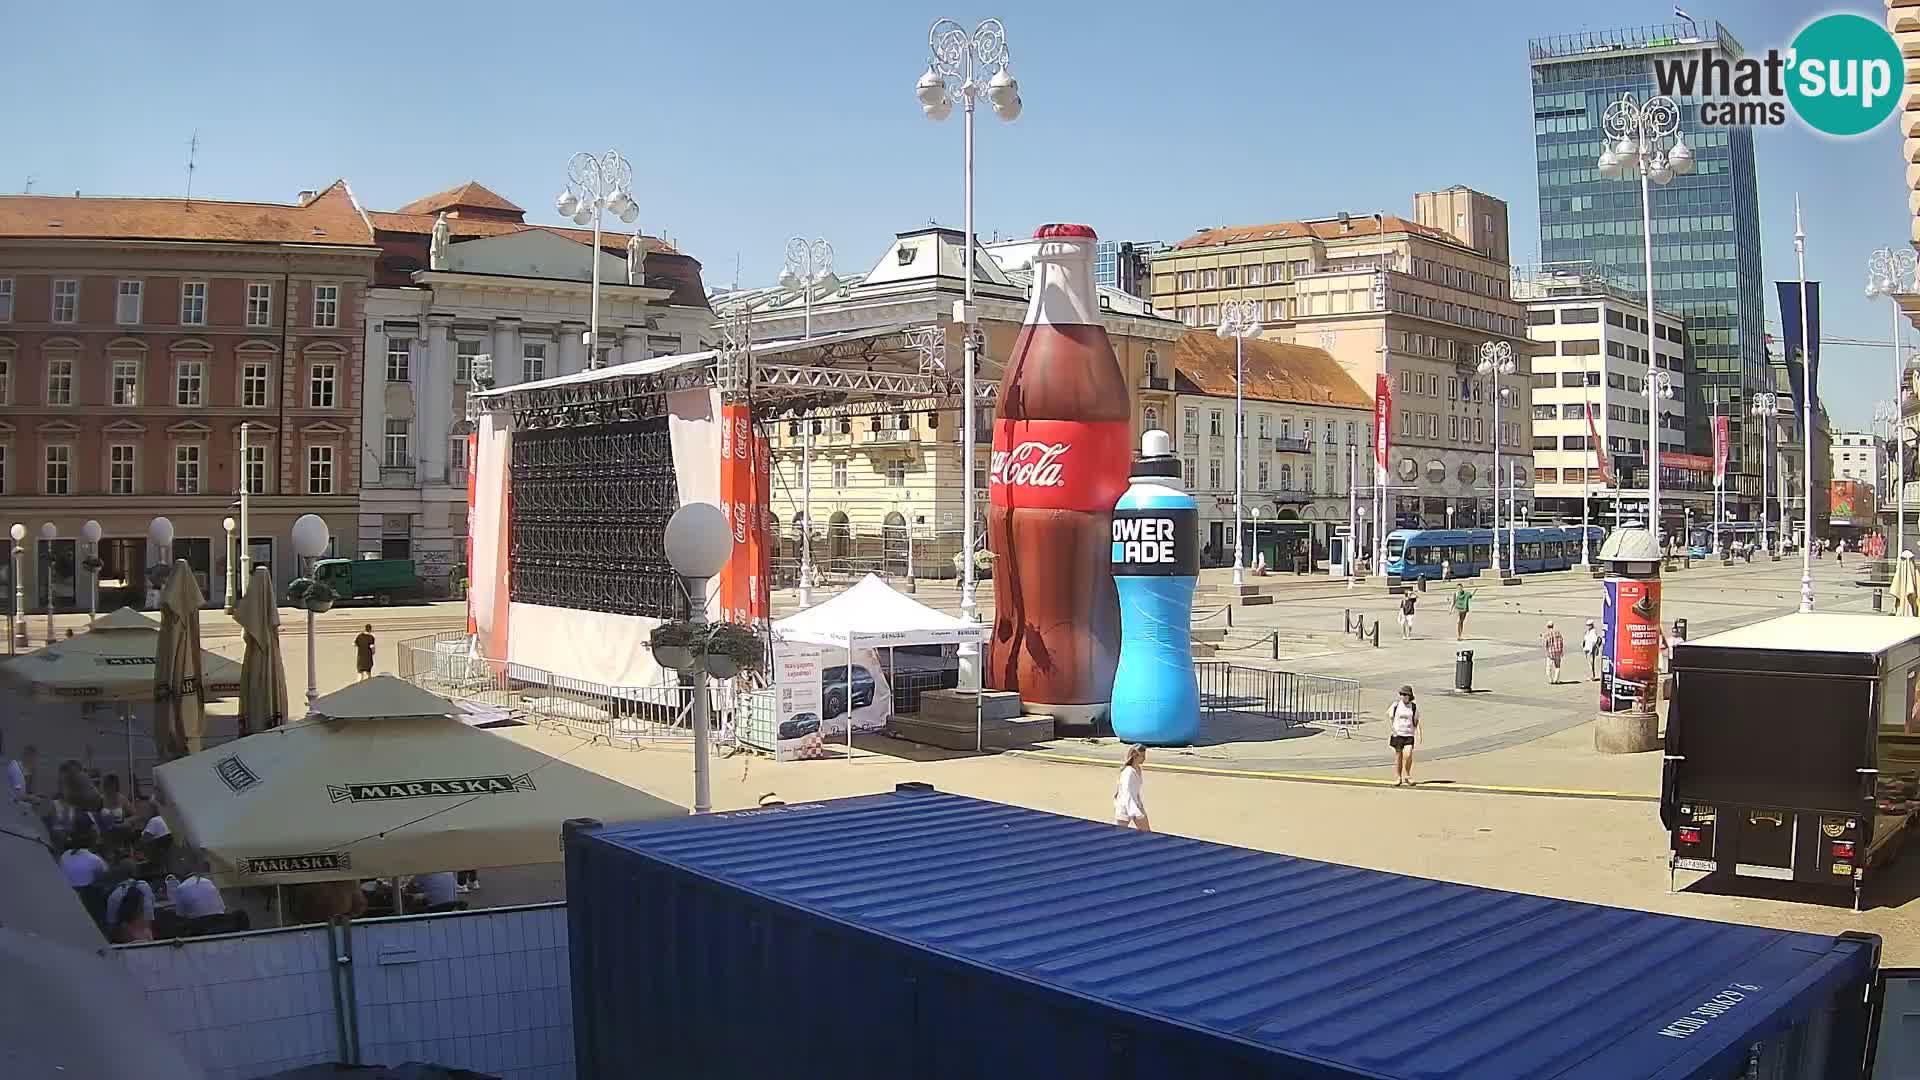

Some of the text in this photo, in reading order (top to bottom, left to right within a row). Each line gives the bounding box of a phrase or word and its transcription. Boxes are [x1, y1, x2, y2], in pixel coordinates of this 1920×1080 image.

[1112, 518, 1175, 541] OWER
[361, 779, 507, 799] MARASKA
[254, 856, 334, 874] MARASKA
